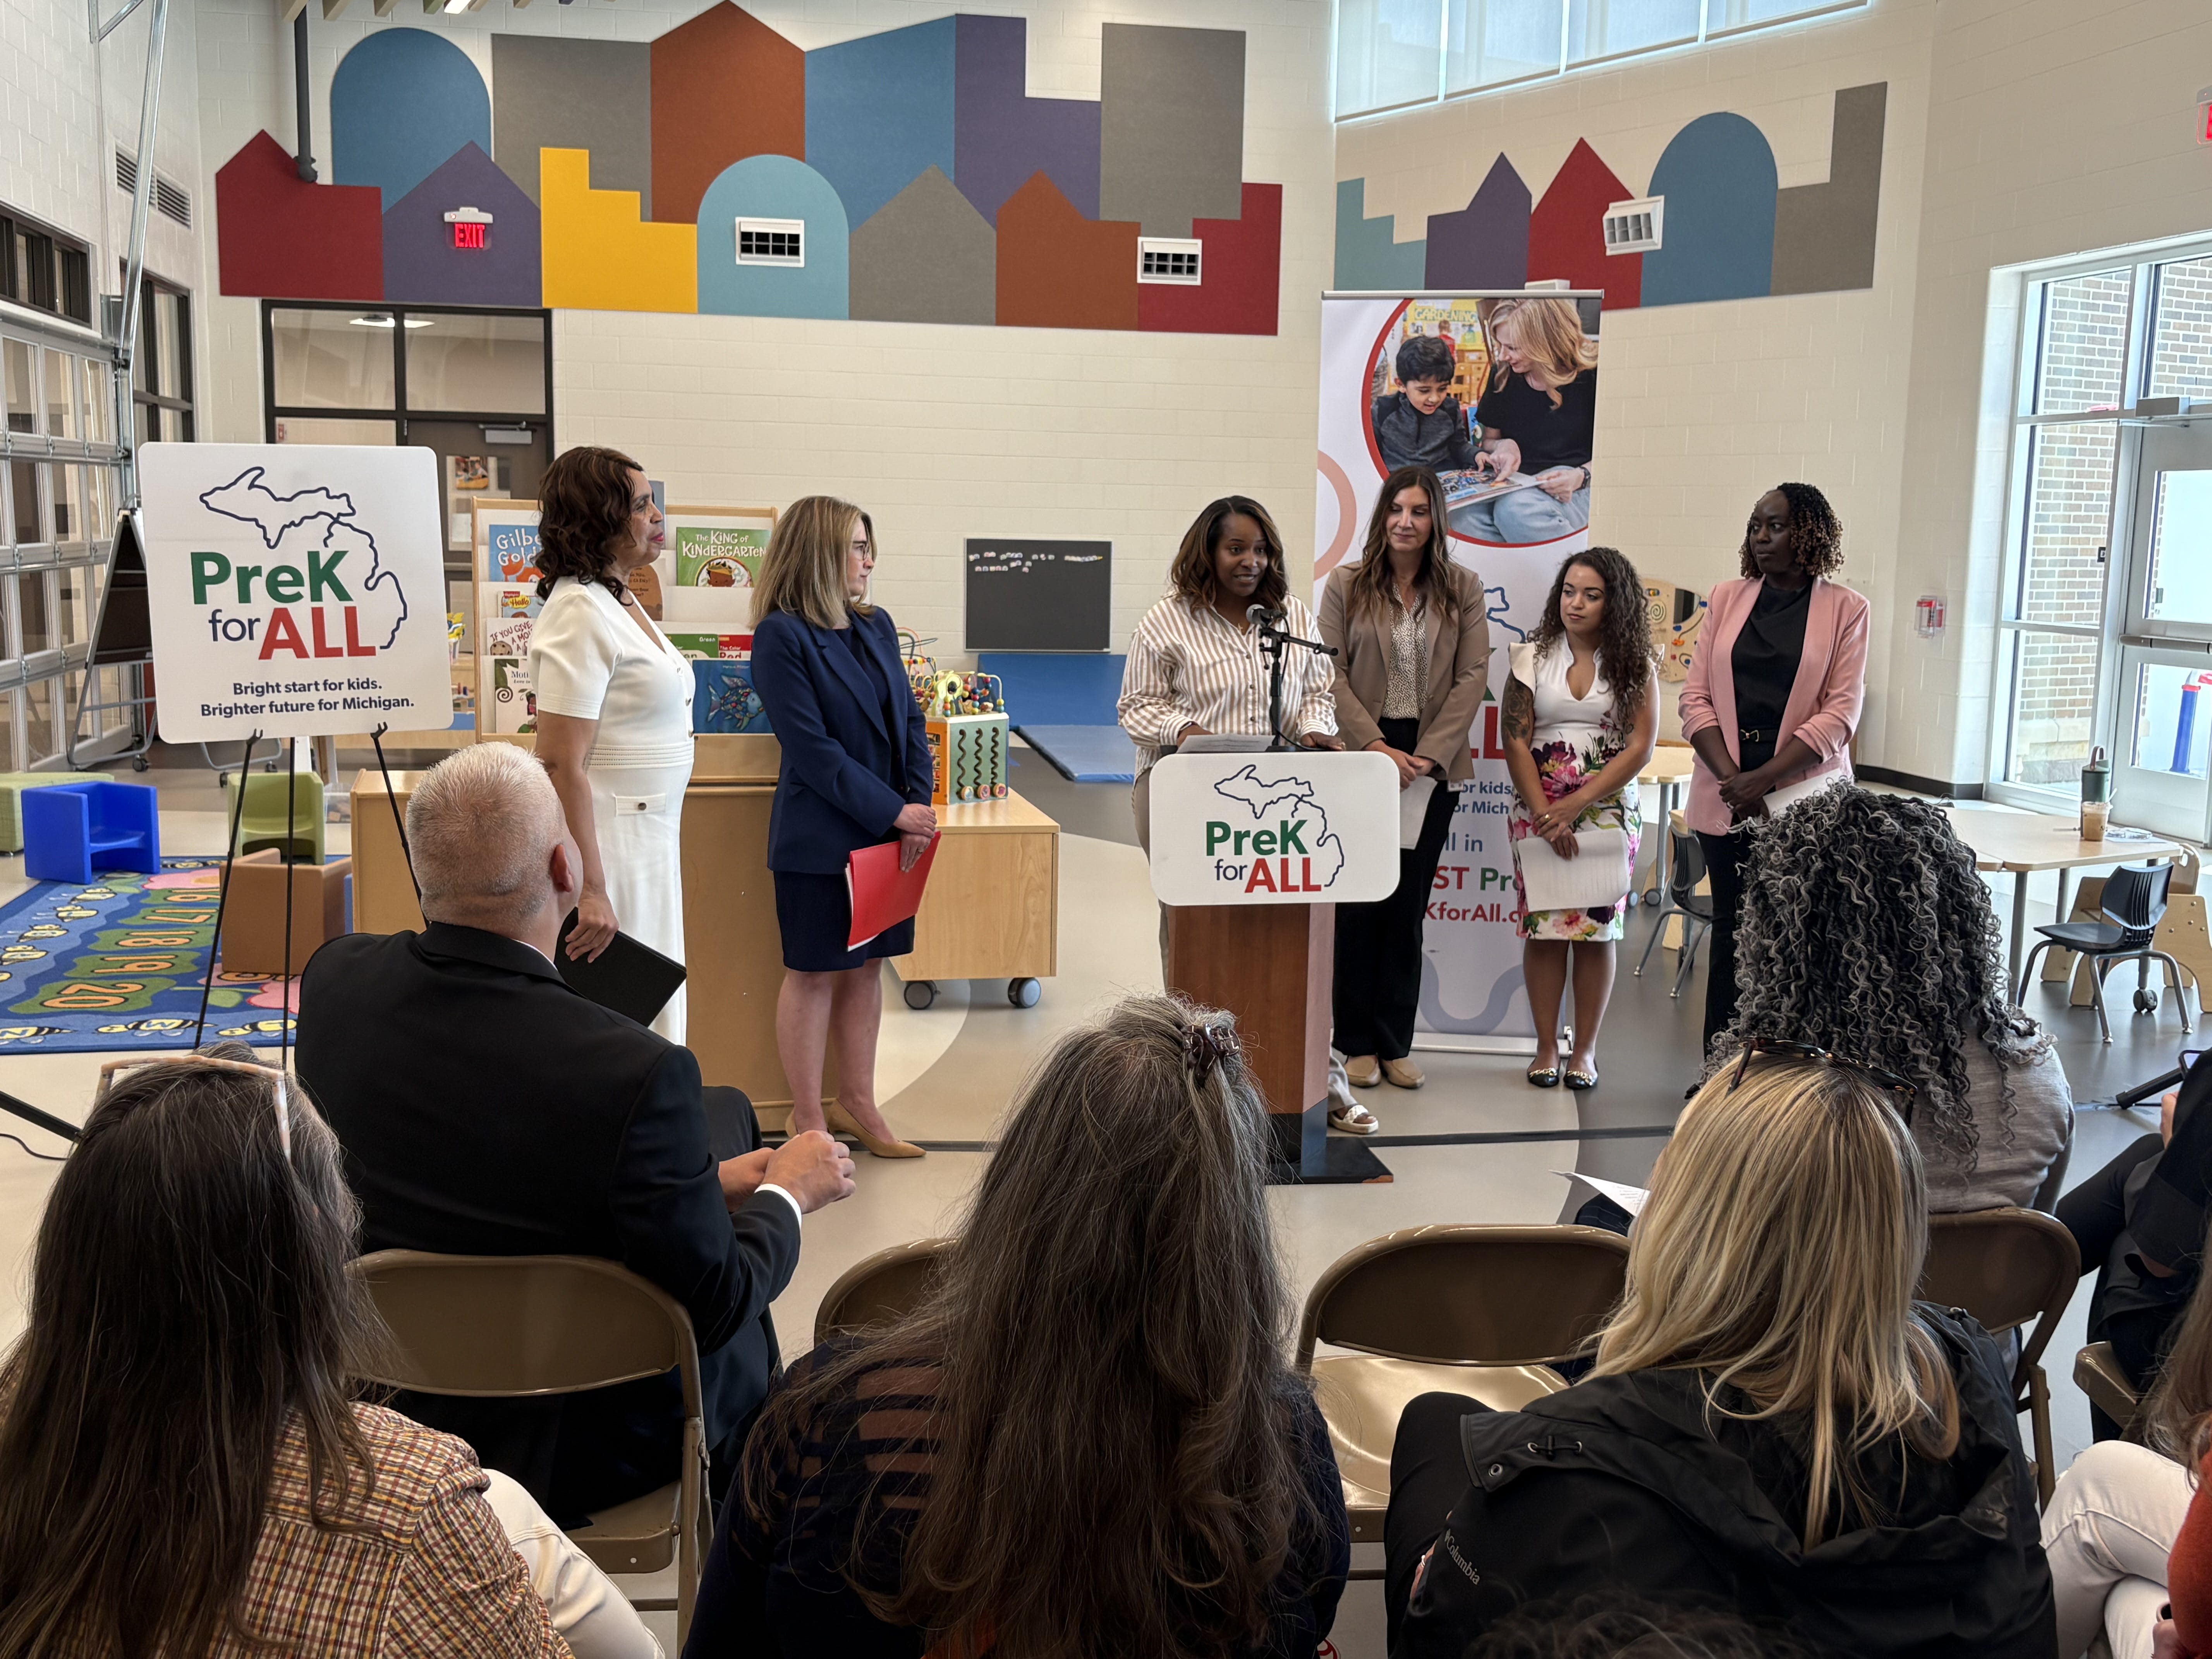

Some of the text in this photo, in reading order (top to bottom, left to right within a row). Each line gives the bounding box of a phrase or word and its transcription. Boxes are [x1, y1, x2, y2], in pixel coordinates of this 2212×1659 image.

[455, 223, 485, 248] EXIT
[1416, 309, 1477, 323] GARDENING
[191, 551, 354, 604] PreK
[208, 606, 376, 660] for ALL
[499, 626, 513, 638] YOU
[514, 621, 533, 632] GIVE
[233, 677, 382, 697] Bright start for kids.
[201, 696, 414, 718] Brighter future for Michigan.
[1454, 800, 1509, 814] or Mich
[1206, 820, 1308, 856] PreK
[1465, 834, 1482, 852] in
[1214, 857, 1322, 893] for ALL
[1433, 866, 1470, 890] ST
[41, 982, 145, 1009] 20
[1447, 1535, 1480, 1585] Columbia
